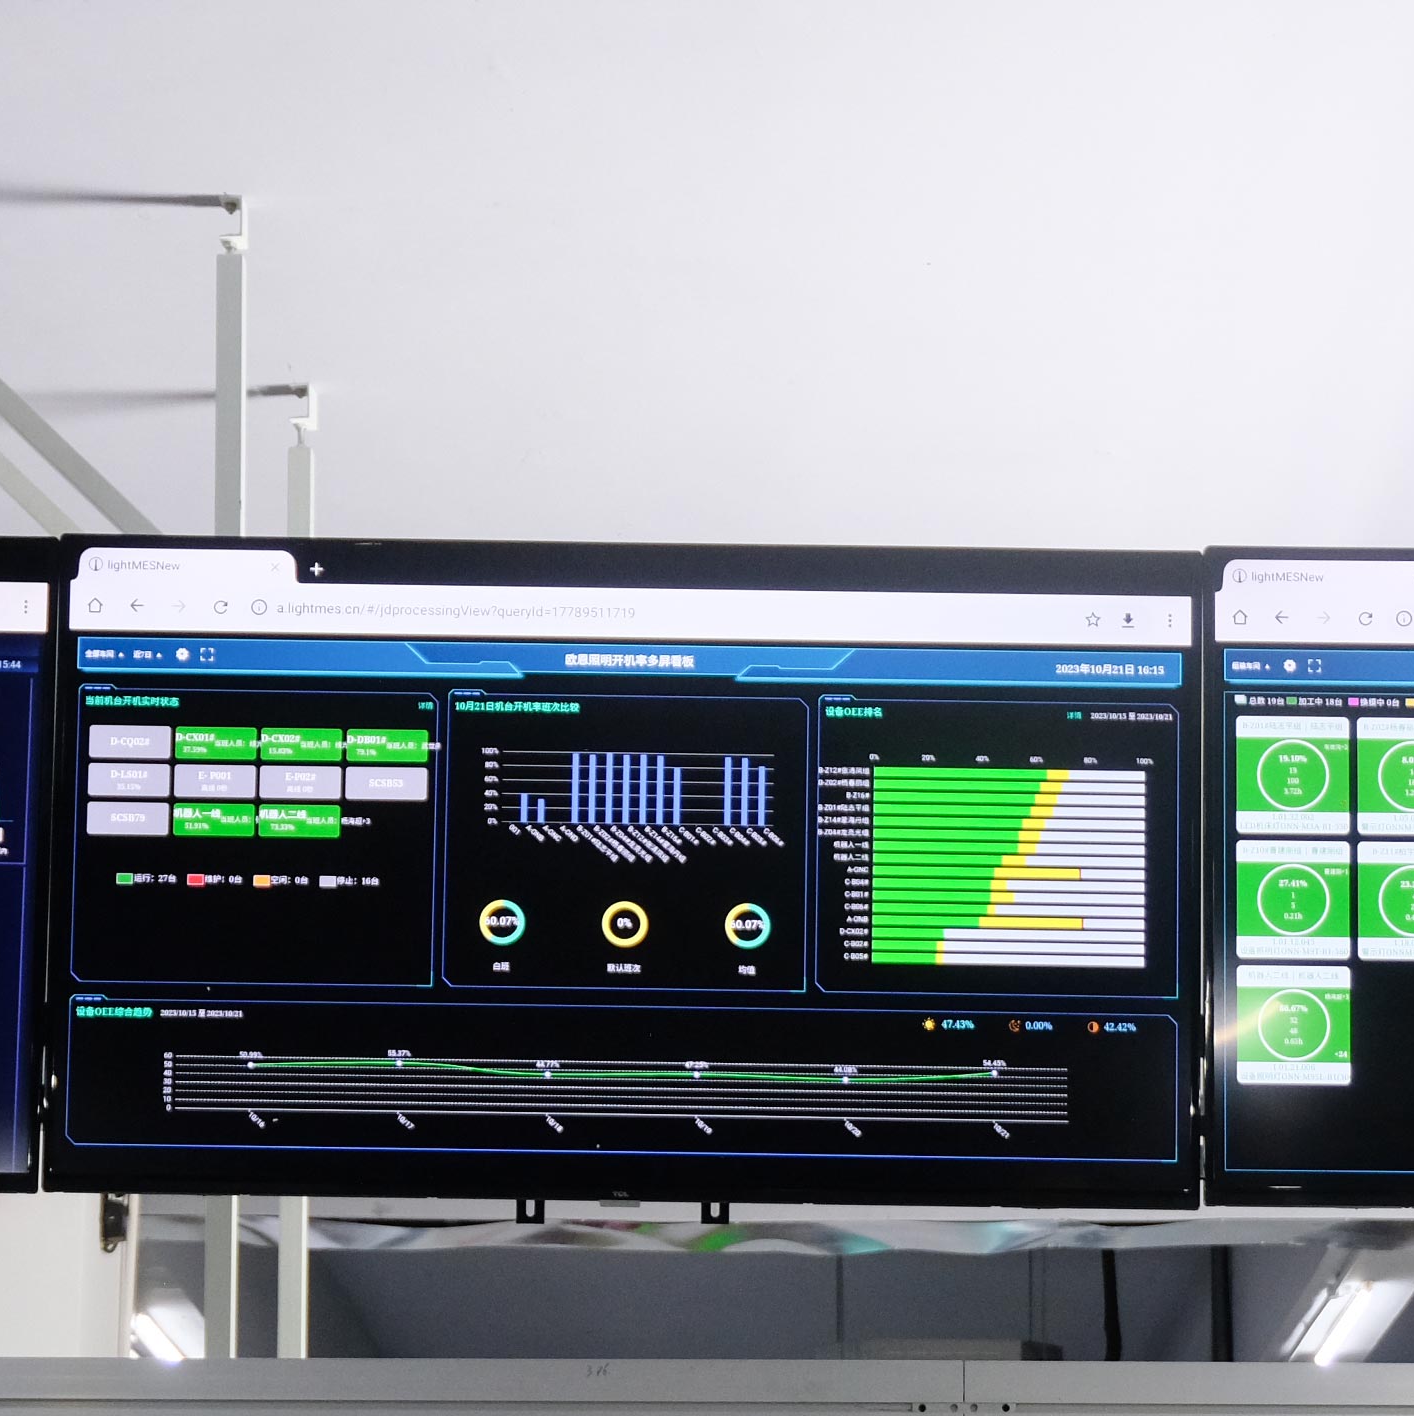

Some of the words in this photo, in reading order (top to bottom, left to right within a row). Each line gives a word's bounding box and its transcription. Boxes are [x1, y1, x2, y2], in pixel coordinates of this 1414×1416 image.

[107, 559, 180, 572] lightMESNew
[1251, 572, 1324, 583] lightMESNew
[565, 653, 695, 668] 欧恩照明开机率多屏看板
[1055, 662, 1135, 675] 2023年10月21日
[85, 695, 179, 708] 当前机台开机实时状态
[455, 701, 580, 713] 10月21日机台开机率班次比较
[825, 706, 882, 718] 设备OEE排名
[110, 736, 150, 747] D-CQ02#
[175, 732, 215, 743] D-CX01#
[261, 733, 300, 744] D-CX02#
[347, 734, 386, 744] D-DB01#
[174, 808, 221, 819] 机器人一线
[259, 809, 307, 820] 机器人二线
[617, 918, 633, 929] 0%
[76, 1005, 153, 1019] 设备OEE综合趋势
[941, 1019, 975, 1030] 47.43%
[1025, 1020, 1053, 1031] 0.00%
[1103, 1022, 1137, 1032] 42.42%
[248, 1111, 266, 1129] 10/16
[396, 1112, 415, 1130] 10/17
